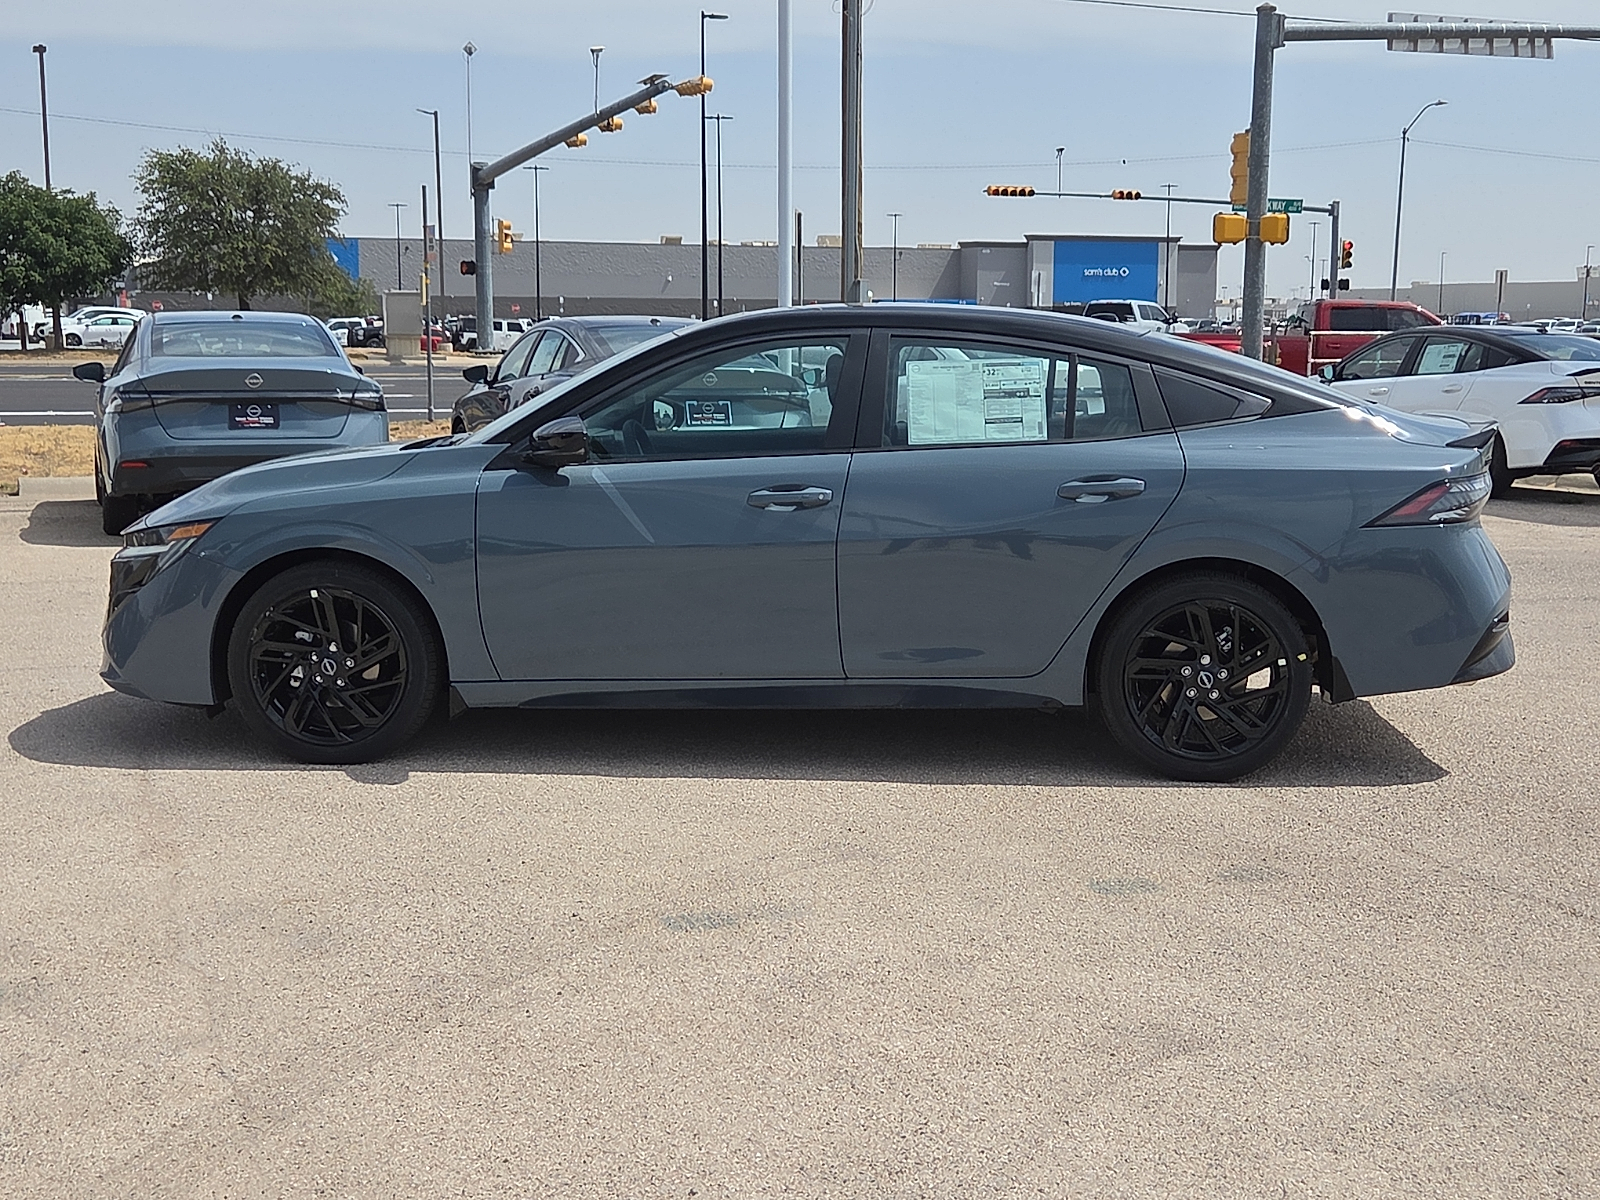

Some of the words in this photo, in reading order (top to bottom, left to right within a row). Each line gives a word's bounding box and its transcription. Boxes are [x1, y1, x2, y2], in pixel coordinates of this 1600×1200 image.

[1083, 267, 1103, 277] sam's
[1103, 267, 1119, 277] club
[986, 368, 996, 376] 32
